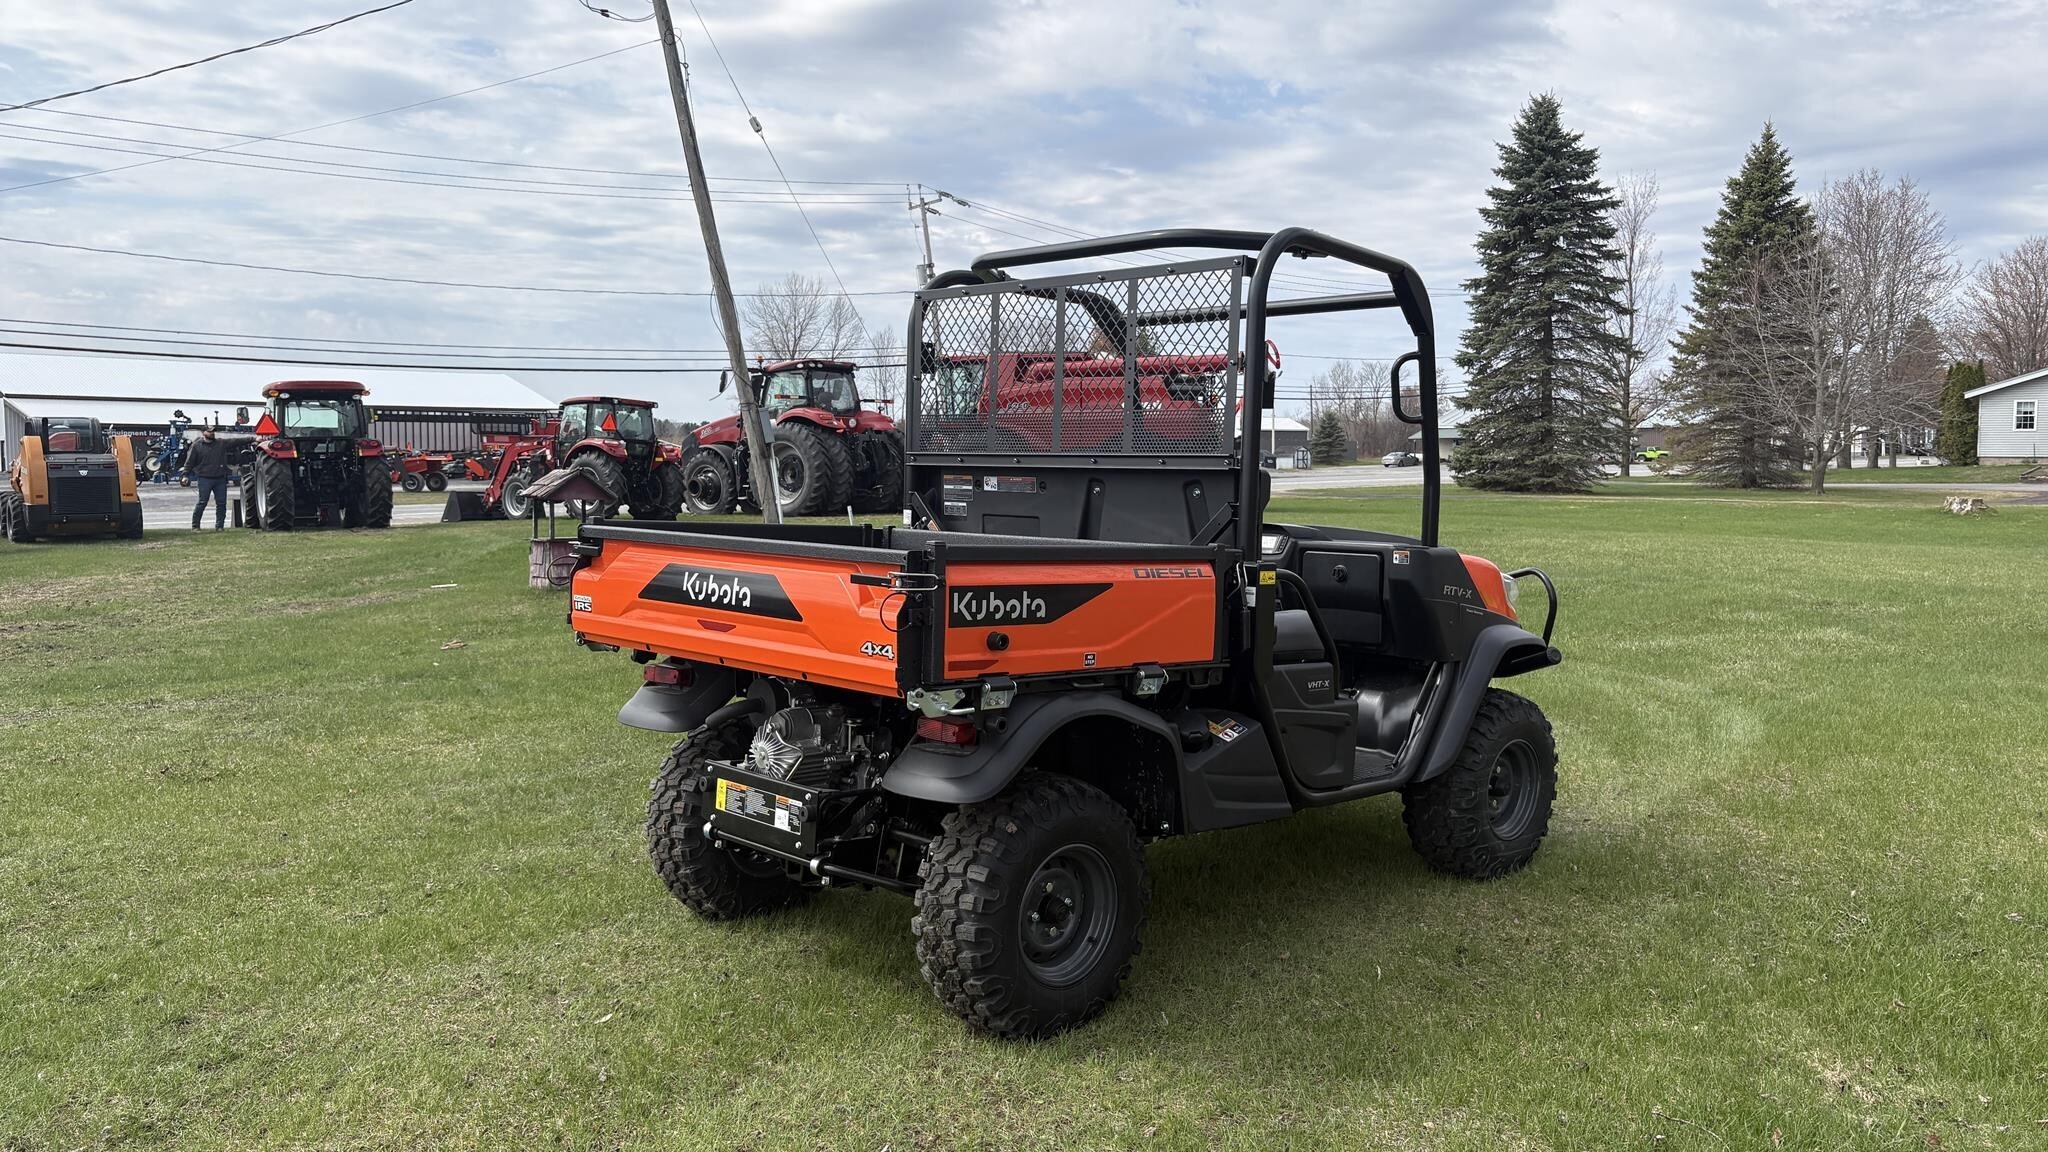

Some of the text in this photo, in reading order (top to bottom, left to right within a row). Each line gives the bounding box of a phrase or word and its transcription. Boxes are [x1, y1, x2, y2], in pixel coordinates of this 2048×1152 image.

[1133, 567, 1213, 578] DIESEL
[682, 571, 751, 608] Kubota
[1443, 585, 1472, 599] RTV-X
[574, 601, 592, 612] IRS
[953, 590, 1046, 621] Kubota
[860, 641, 895, 660] 4x4
[1307, 680, 1330, 689] VHT-X
